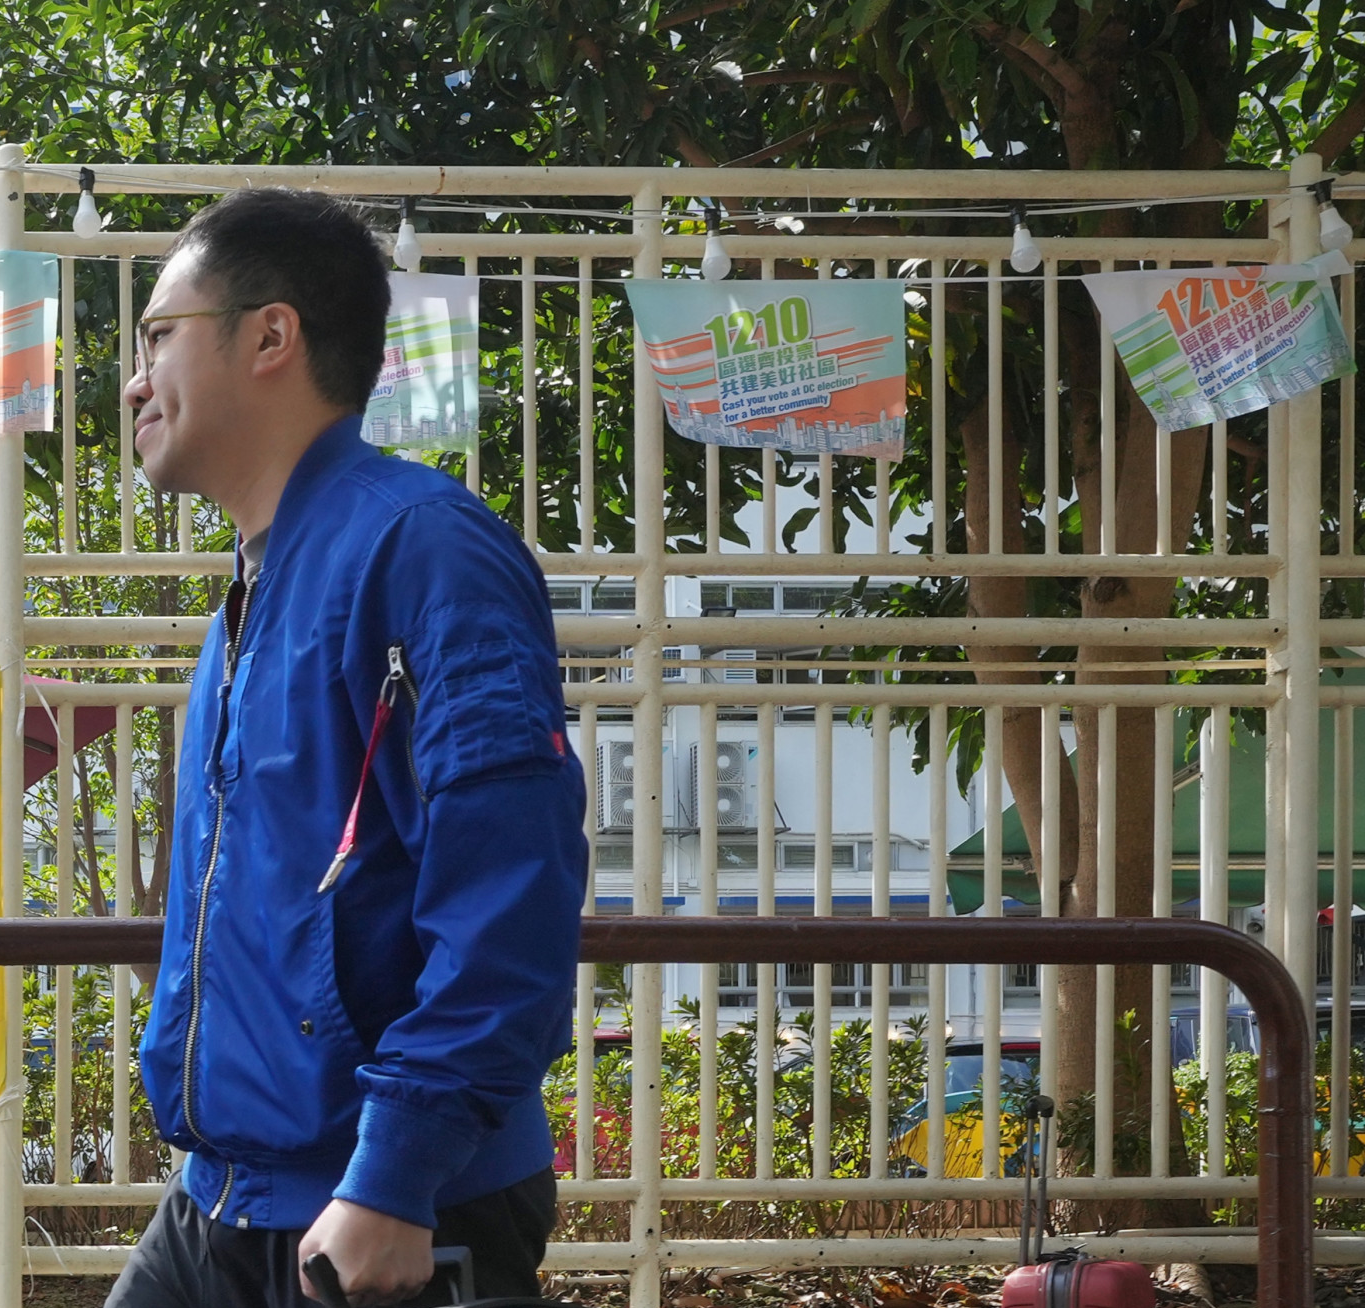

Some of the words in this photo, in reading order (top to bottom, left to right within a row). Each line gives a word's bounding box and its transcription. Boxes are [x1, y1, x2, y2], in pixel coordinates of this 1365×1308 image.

[704, 297, 809, 359] 1210
[1180, 288, 1268, 355] 區選齊投票
[1191, 297, 1290, 374] 共建美好社區
[1197, 370, 1216, 386] Cast
[1217, 362, 1233, 377] your
[1234, 349, 1253, 363] vote
[1255, 342, 1263, 352] at
[1264, 335, 1275, 347] DC
[1276, 304, 1311, 337] election
[381, 366, 421, 382] election
[718, 341, 814, 380] 區選齊投票
[720, 357, 835, 399] 共建美好社區
[1204, 386, 1215, 397] for
[1217, 382, 1222, 390] a
[1222, 368, 1246, 386] better
[1247, 334, 1294, 371] community
[722, 399, 744, 412] Cast
[747, 396, 766, 408] your
[769, 390, 788, 401] vote
[792, 387, 800, 395] at
[804, 383, 814, 393] DC
[818, 376, 853, 391] election
[725, 414, 738, 423] for
[751, 406, 775, 416] better
[779, 395, 828, 412] community
